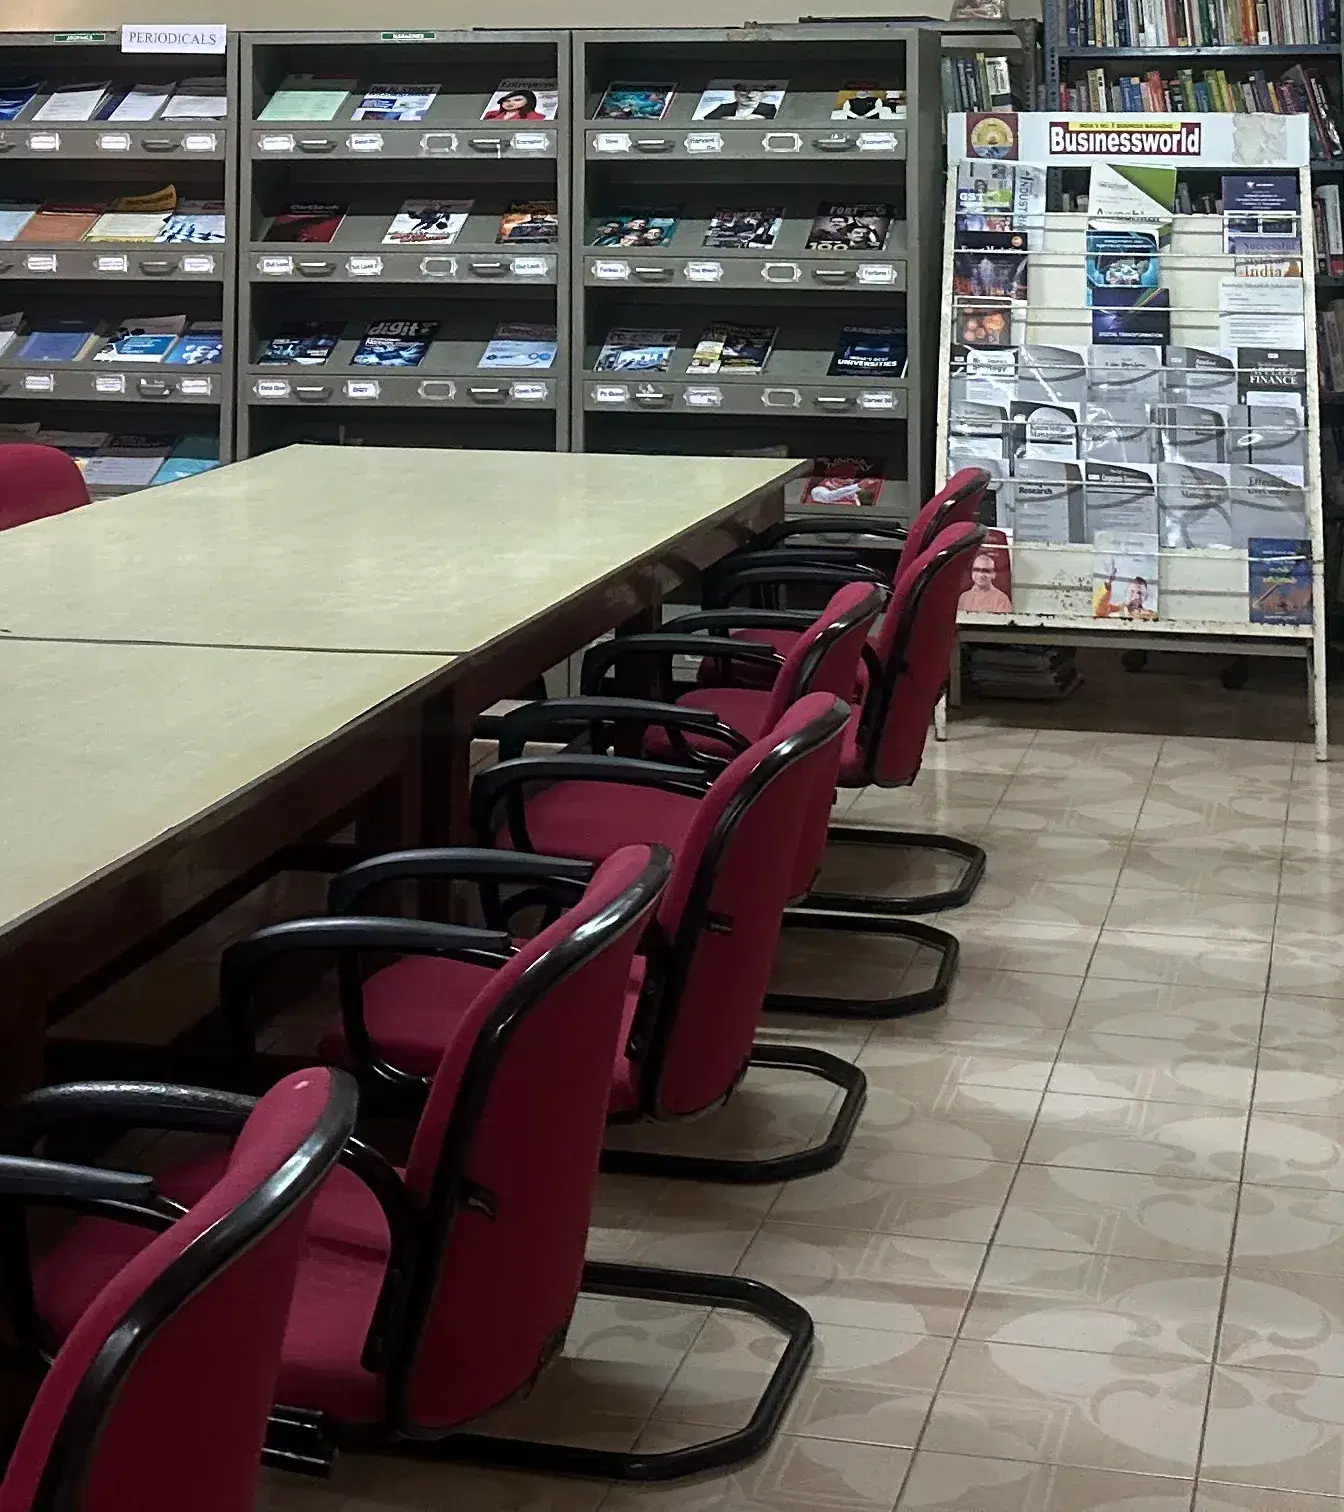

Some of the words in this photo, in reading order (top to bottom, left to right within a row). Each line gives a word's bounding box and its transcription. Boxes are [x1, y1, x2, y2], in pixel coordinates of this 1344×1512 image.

[129, 31, 217, 46] PERIODICALS
[1050, 126, 1200, 153] Businessworld
[959, 192, 985, 202] GST
[1244, 265, 1283, 277] India
[367, 321, 419, 336] digit
[837, 358, 898, 367] UNIVERSITIES
[1249, 375, 1298, 385] FINANCE
[1018, 486, 1054, 496] Research
